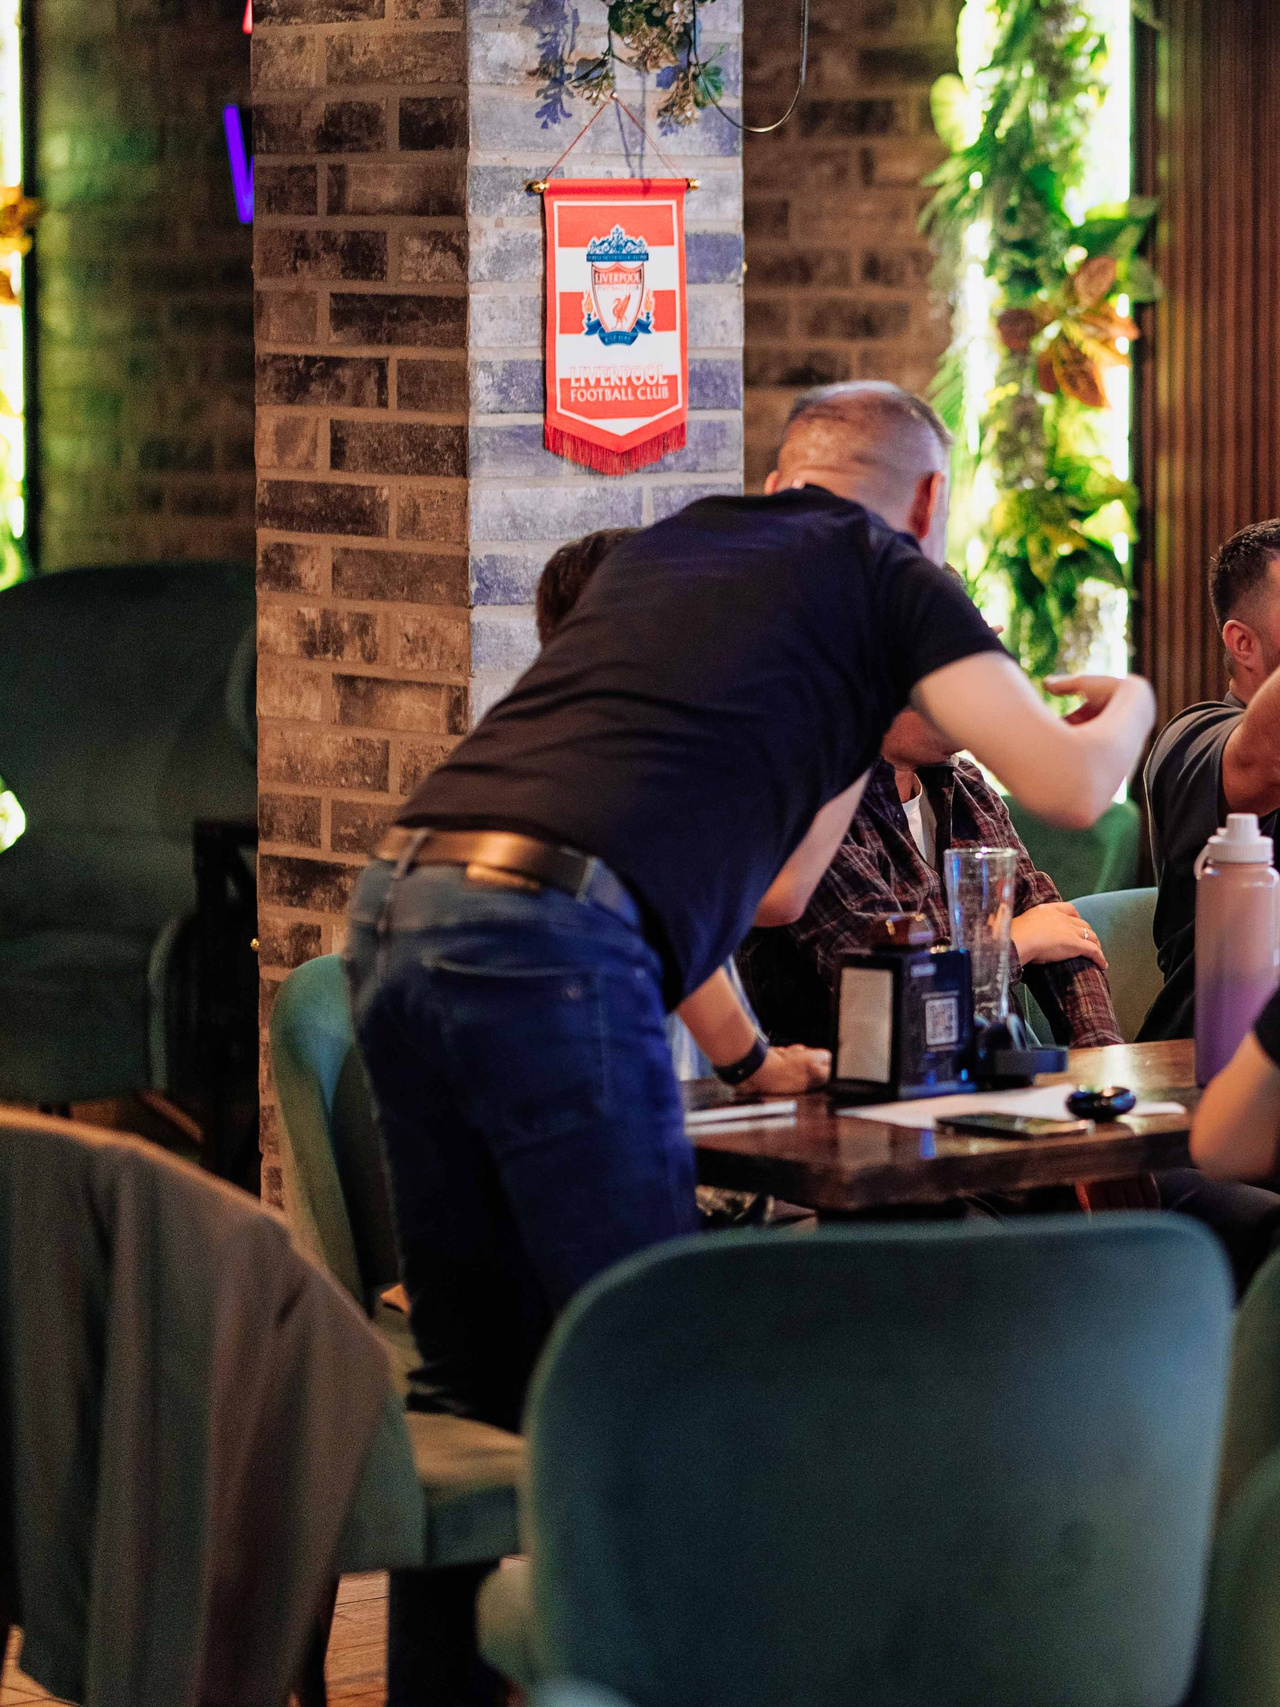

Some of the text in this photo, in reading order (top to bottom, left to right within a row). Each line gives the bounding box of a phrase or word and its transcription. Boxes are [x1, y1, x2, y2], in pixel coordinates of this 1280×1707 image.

[595, 272, 640, 284] LIVERPOOL
[570, 363, 668, 387] LIVERPOOL
[570, 386, 669, 402] FOOTBALL CLUB
